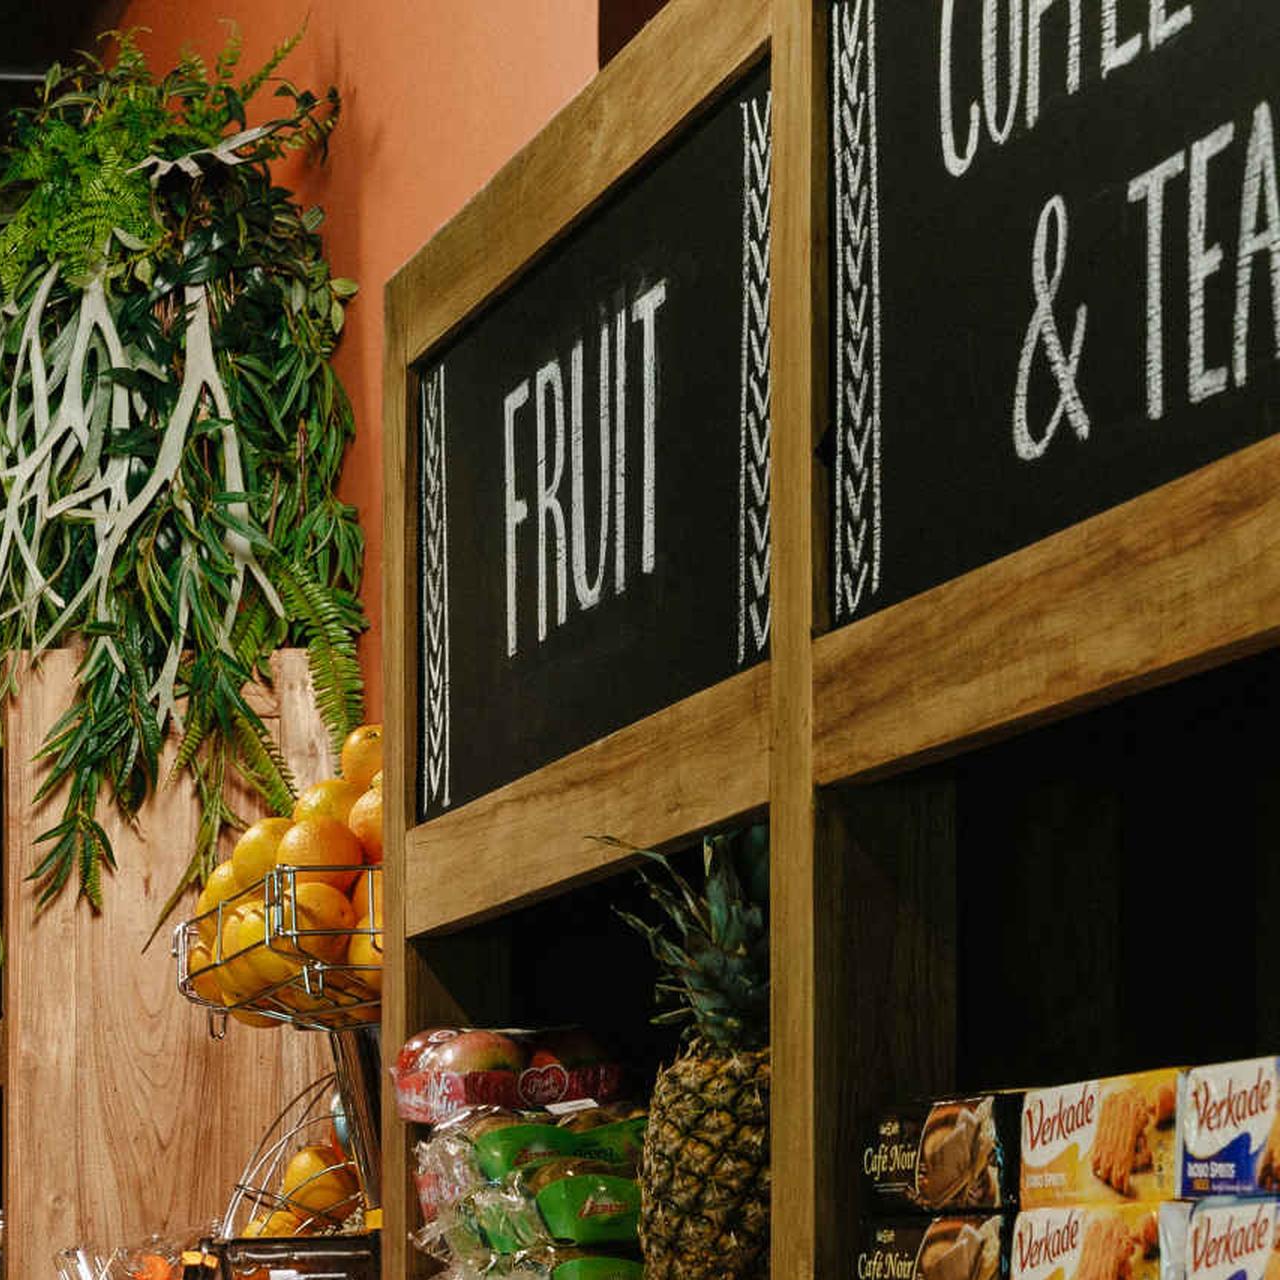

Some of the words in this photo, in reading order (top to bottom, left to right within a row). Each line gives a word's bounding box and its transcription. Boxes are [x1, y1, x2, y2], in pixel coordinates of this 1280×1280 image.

[1015, 195, 1090, 461] &
[1127, 101, 1280, 421] TEA
[504, 278, 666, 657] FRUIT
[1025, 1084, 1096, 1150] Verkade
[1192, 1067, 1272, 1132] Verkade
[864, 1143, 888, 1181] Café
[889, 1144, 917, 1172] Noir
[887, 1252, 914, 1280] Noir
[1017, 1210, 1079, 1272] Verkade
[1192, 1205, 1270, 1273] Verkade
